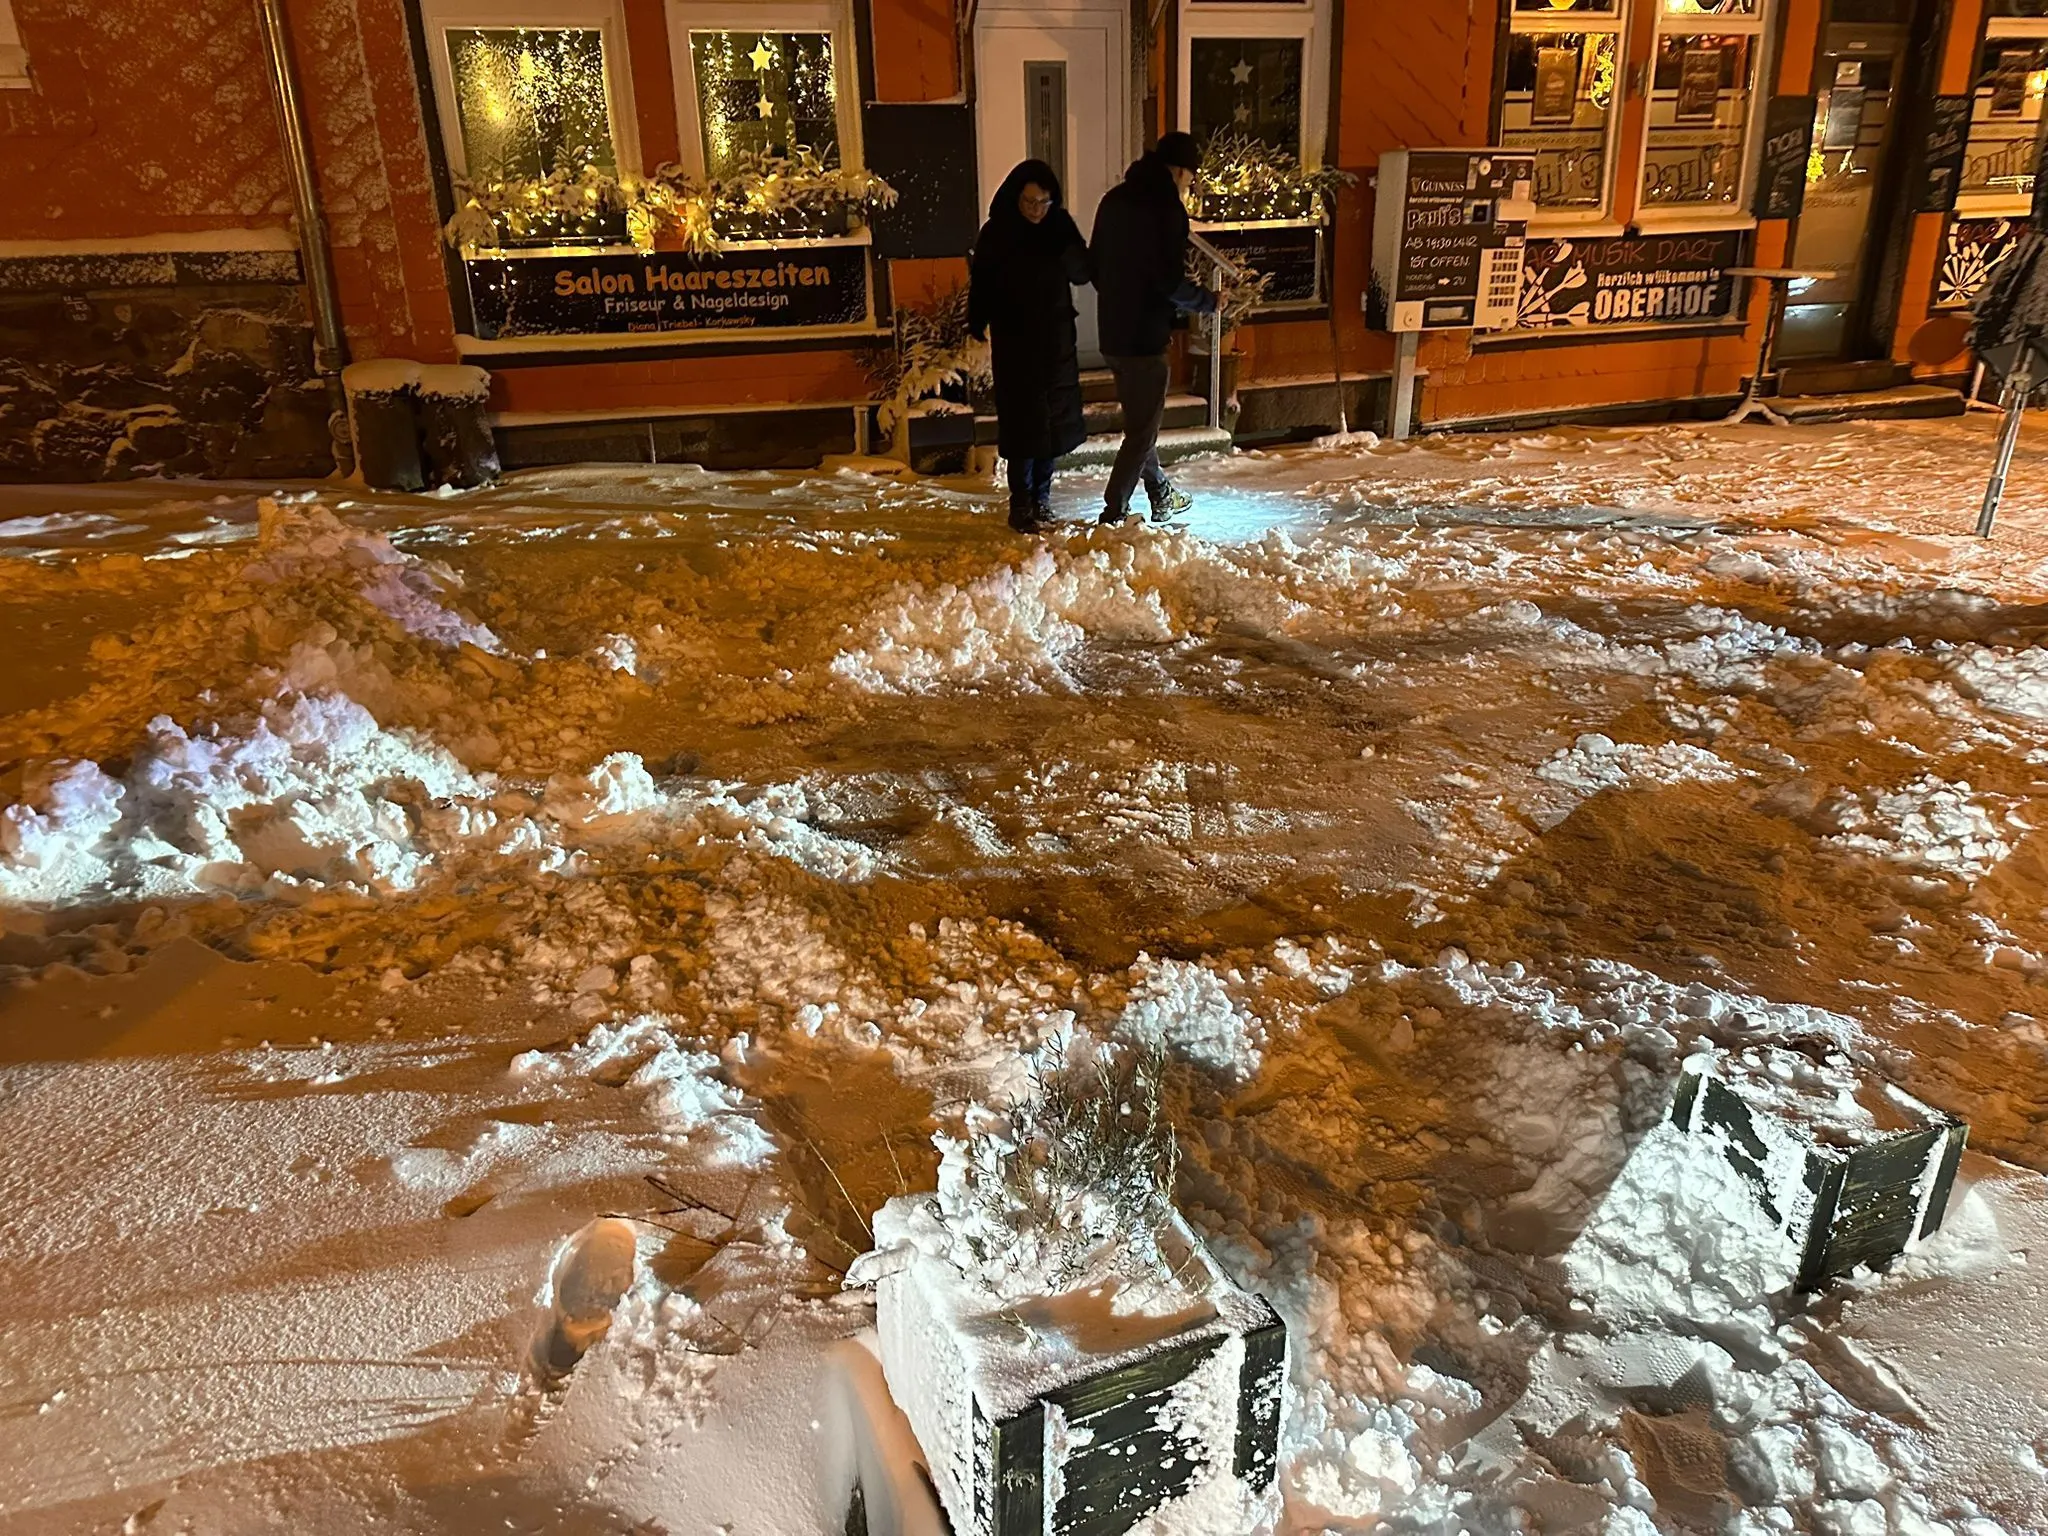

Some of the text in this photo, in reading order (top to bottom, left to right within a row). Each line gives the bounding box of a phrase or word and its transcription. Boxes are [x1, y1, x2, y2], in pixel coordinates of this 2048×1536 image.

[1420, 179, 1465, 193] GUINNESS
[1404, 237, 1423, 249] AB
[1426, 238, 1451, 249] 19:30
[1573, 241, 1647, 266] MUSIK
[1656, 239, 1724, 264] DART
[1409, 256, 1428, 268] IST
[554, 262, 830, 296] Salon Haareszeiten
[1597, 271, 1643, 288] Herzlich
[1644, 269, 1708, 285] willkommen
[604, 291, 789, 314] Friseur & Nageldesign
[1594, 284, 1719, 320] OBERHOF
[627, 320, 656, 331] Diana
